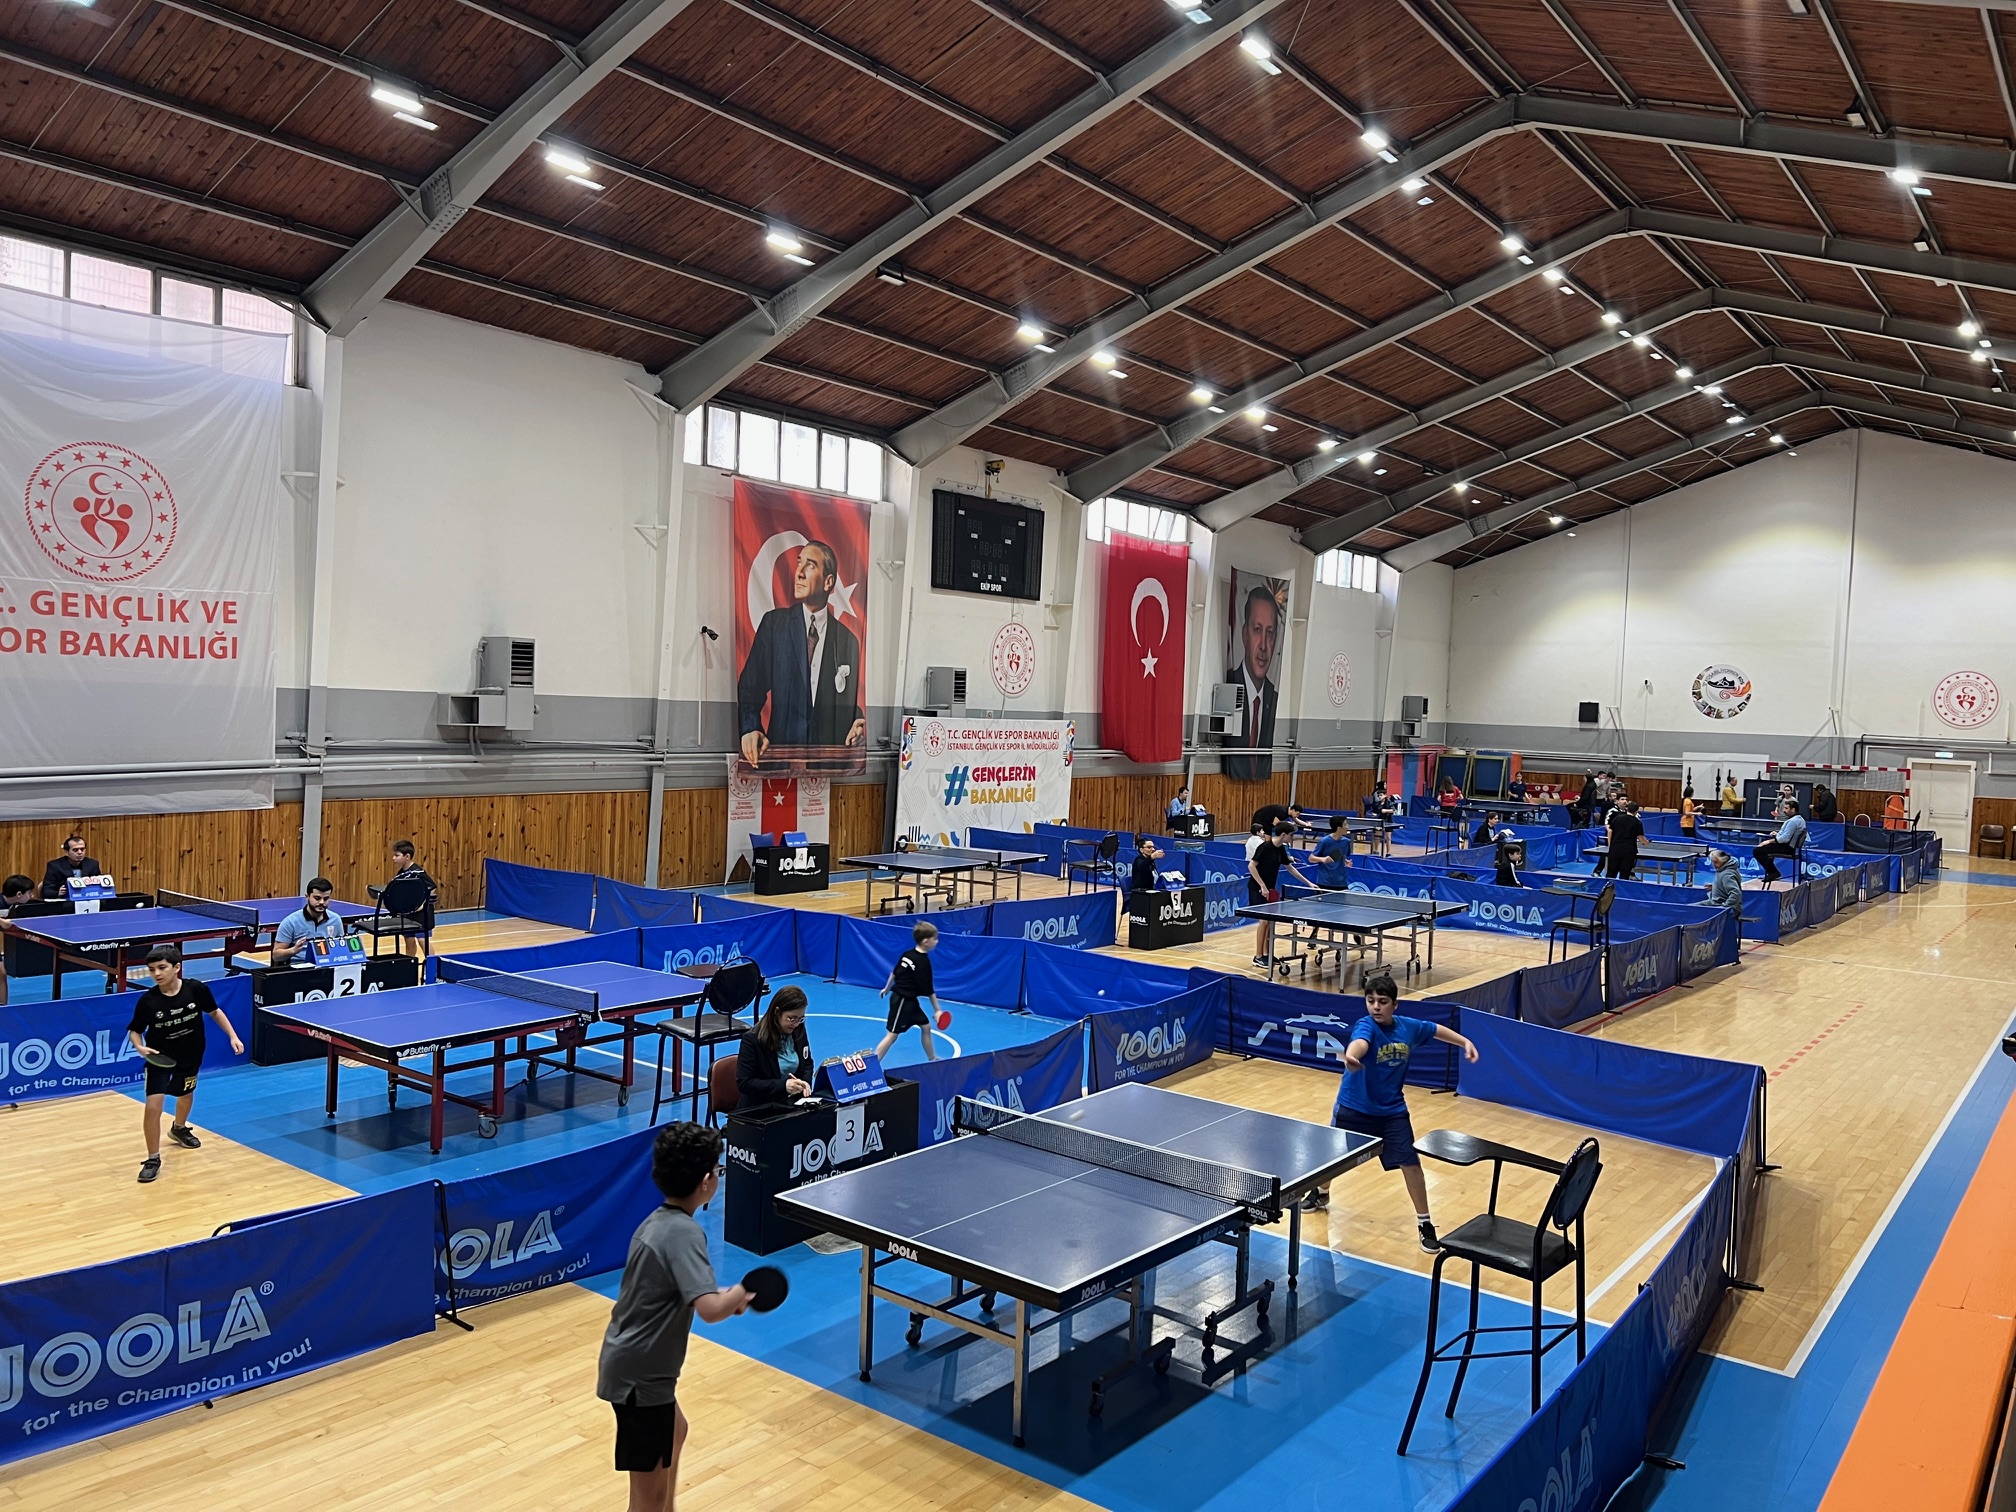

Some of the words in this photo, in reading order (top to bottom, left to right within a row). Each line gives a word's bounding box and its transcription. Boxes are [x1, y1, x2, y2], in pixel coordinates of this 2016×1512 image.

[30, 591, 190, 627] GENÇLİK
[201, 600, 238, 624] VE
[0, 627, 47, 654] OR
[60, 630, 238, 660] BAKANLIĞI
[947, 729, 960, 740] T.C.
[962, 729, 993, 742] GENÇLİK
[994, 731, 1003, 740] VE
[1005, 730, 1023, 740] SPOR
[1024, 729, 1060, 740] BAKANLIĞI
[947, 741, 974, 750] İSTANBUL
[975, 741, 998, 751] GENÇLİK
[1026, 741, 1059, 750] MÜDÜRLÜĞÜ
[972, 763, 1036, 786] GENÇLERİN
[970, 783, 1036, 805] BAKANLIĞI
[779, 856, 816, 872] JOA
[103, 878, 111, 886] 0
[1173, 893, 1179, 906] 5
[1468, 900, 1545, 926] JOOLA
[1022, 914, 1080, 941] JOOLA
[1499, 924, 1532, 936] Champion
[317, 941, 326, 955] 1
[350, 938, 358, 951] 0
[1623, 954, 1659, 988] JOOLA
[340, 978, 355, 996] 2
[410, 1043, 439, 1056] Butterfly
[1116, 1016, 1186, 1066] JOOLA
[1248, 1021, 1346, 1062] STA
[845, 1061, 853, 1071] 0
[857, 1058, 865, 1068] 0
[1114, 1069, 1126, 1080] FOR
[1127, 1065, 1136, 1077] THE
[1136, 1058, 1168, 1073] CHAMPION
[8, 1083, 30, 1096] for
[34, 1078, 57, 1090] the
[61, 1073, 131, 1089] Champion
[134, 1072, 146, 1080] in
[845, 1119, 855, 1142] 3
[728, 1144, 757, 1166] JOOLA
[814, 1170, 828, 1183] the
[1248, 1207, 1268, 1218] JOOLA
[888, 1241, 918, 1261] JOOLA
[445, 1280, 532, 1301] Champion
[538, 1273, 552, 1286] in
[557, 1253, 591, 1281] you!
[1081, 1279, 1106, 1301] JOOLA
[22, 1409, 60, 1435] for
[68, 1395, 109, 1418] the
[117, 1373, 235, 1407] Champion
[243, 1363, 262, 1381] in
[267, 1337, 312, 1374] you!
